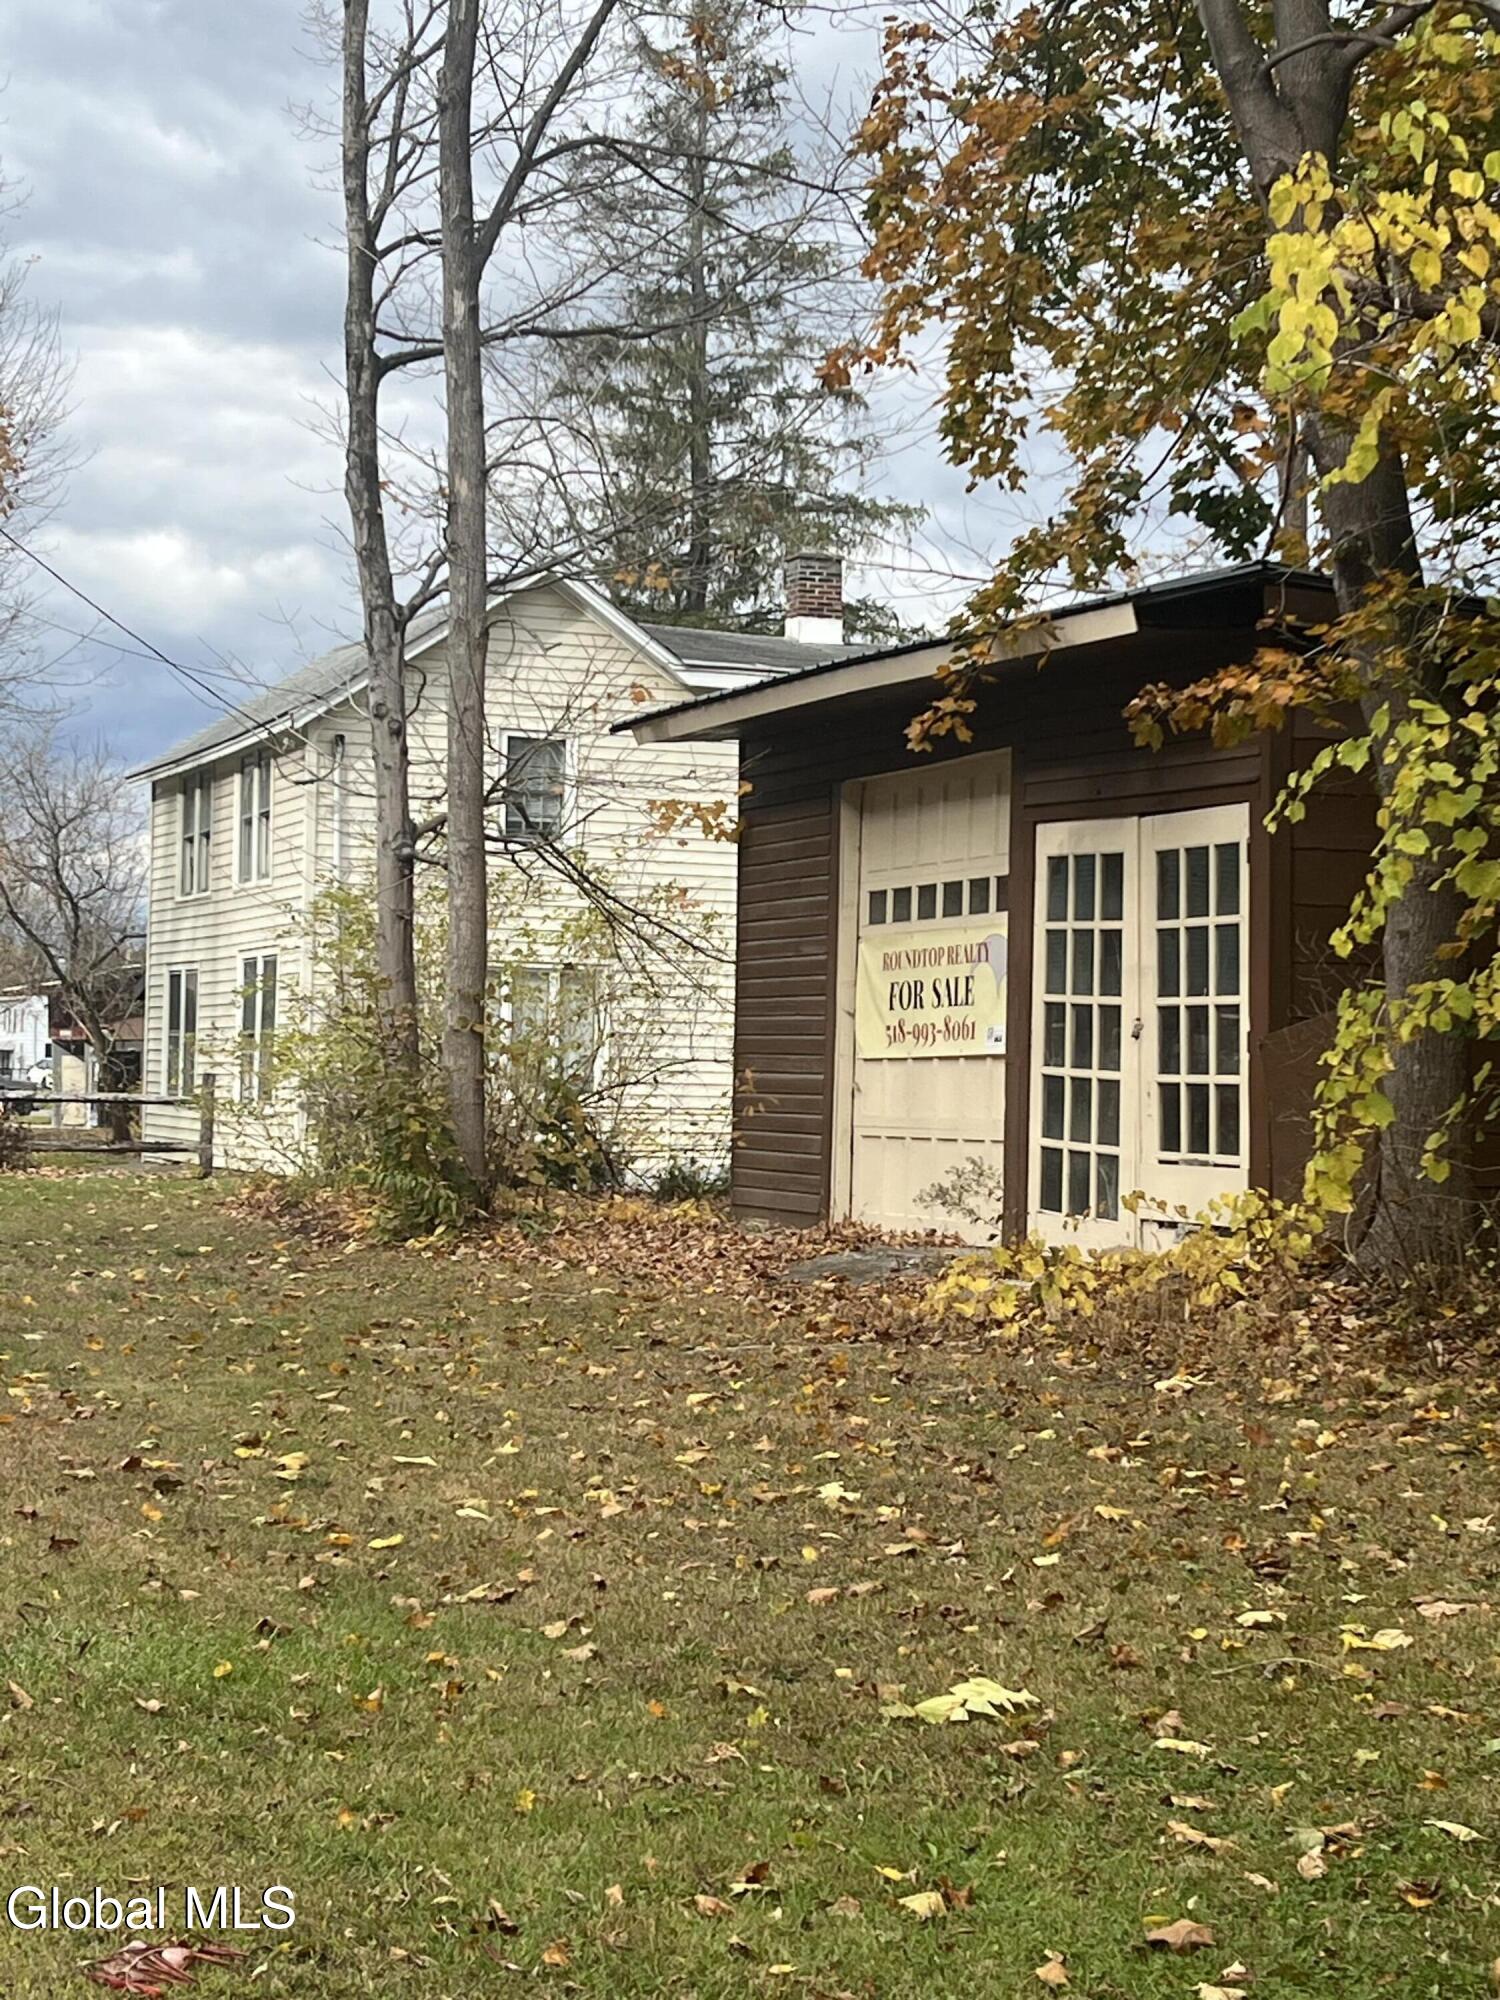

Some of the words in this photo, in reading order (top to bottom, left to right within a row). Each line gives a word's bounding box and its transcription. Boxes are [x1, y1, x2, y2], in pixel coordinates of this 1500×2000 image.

[882, 947, 944, 971] ROUNDTOP
[947, 942, 989, 964] REALTY
[889, 979, 924, 1011] FOR
[931, 975, 975, 1009] SALE
[886, 1014, 976, 1048] 518-993-8061
